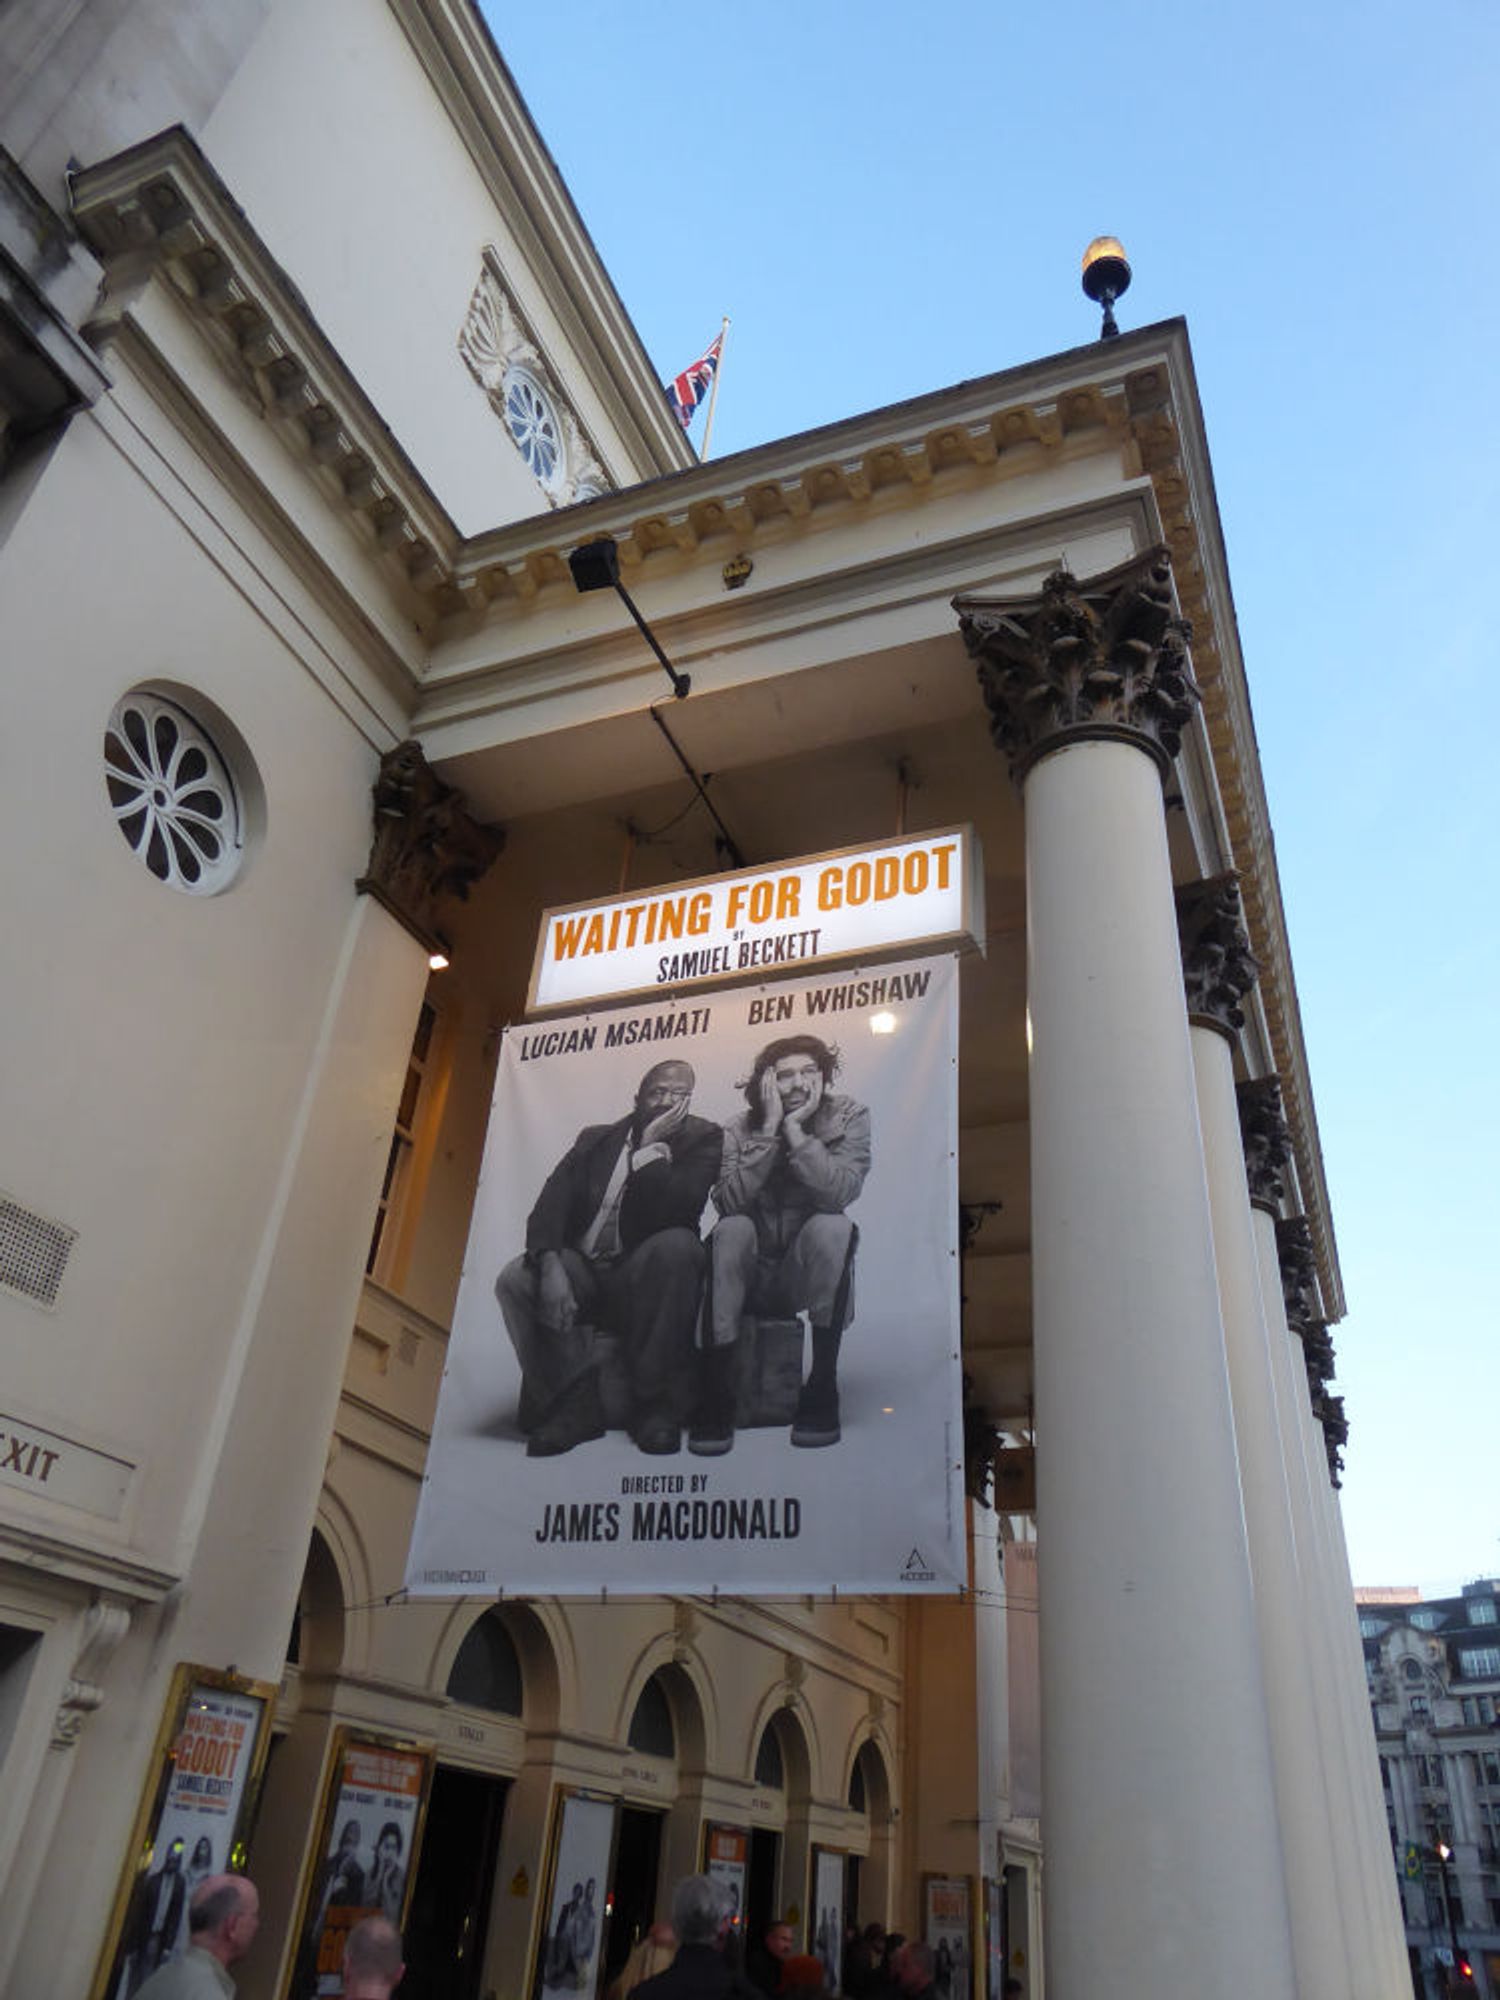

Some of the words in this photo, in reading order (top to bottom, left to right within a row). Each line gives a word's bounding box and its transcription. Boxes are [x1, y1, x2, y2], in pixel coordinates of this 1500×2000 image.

[554, 892, 713, 961] WAITING
[726, 875, 802, 929] FOR
[817, 844, 957, 911] GODOT
[656, 944, 731, 984] SAMUEL
[737, 929, 822, 970] BECKETT
[732, 930, 746, 942] BY
[520, 1027, 597, 1062] LUCIAN
[603, 1008, 711, 1048] MSAMATI
[748, 994, 794, 1026] BEN
[805, 970, 932, 1016] WHISHAW
[621, 1475, 685, 1495] DIRECTED
[690, 1474, 708, 1493] BY
[535, 1502, 620, 1543] JAMES
[631, 1498, 801, 1542] MACDONALD
[177, 1734, 242, 1779] GODOT
